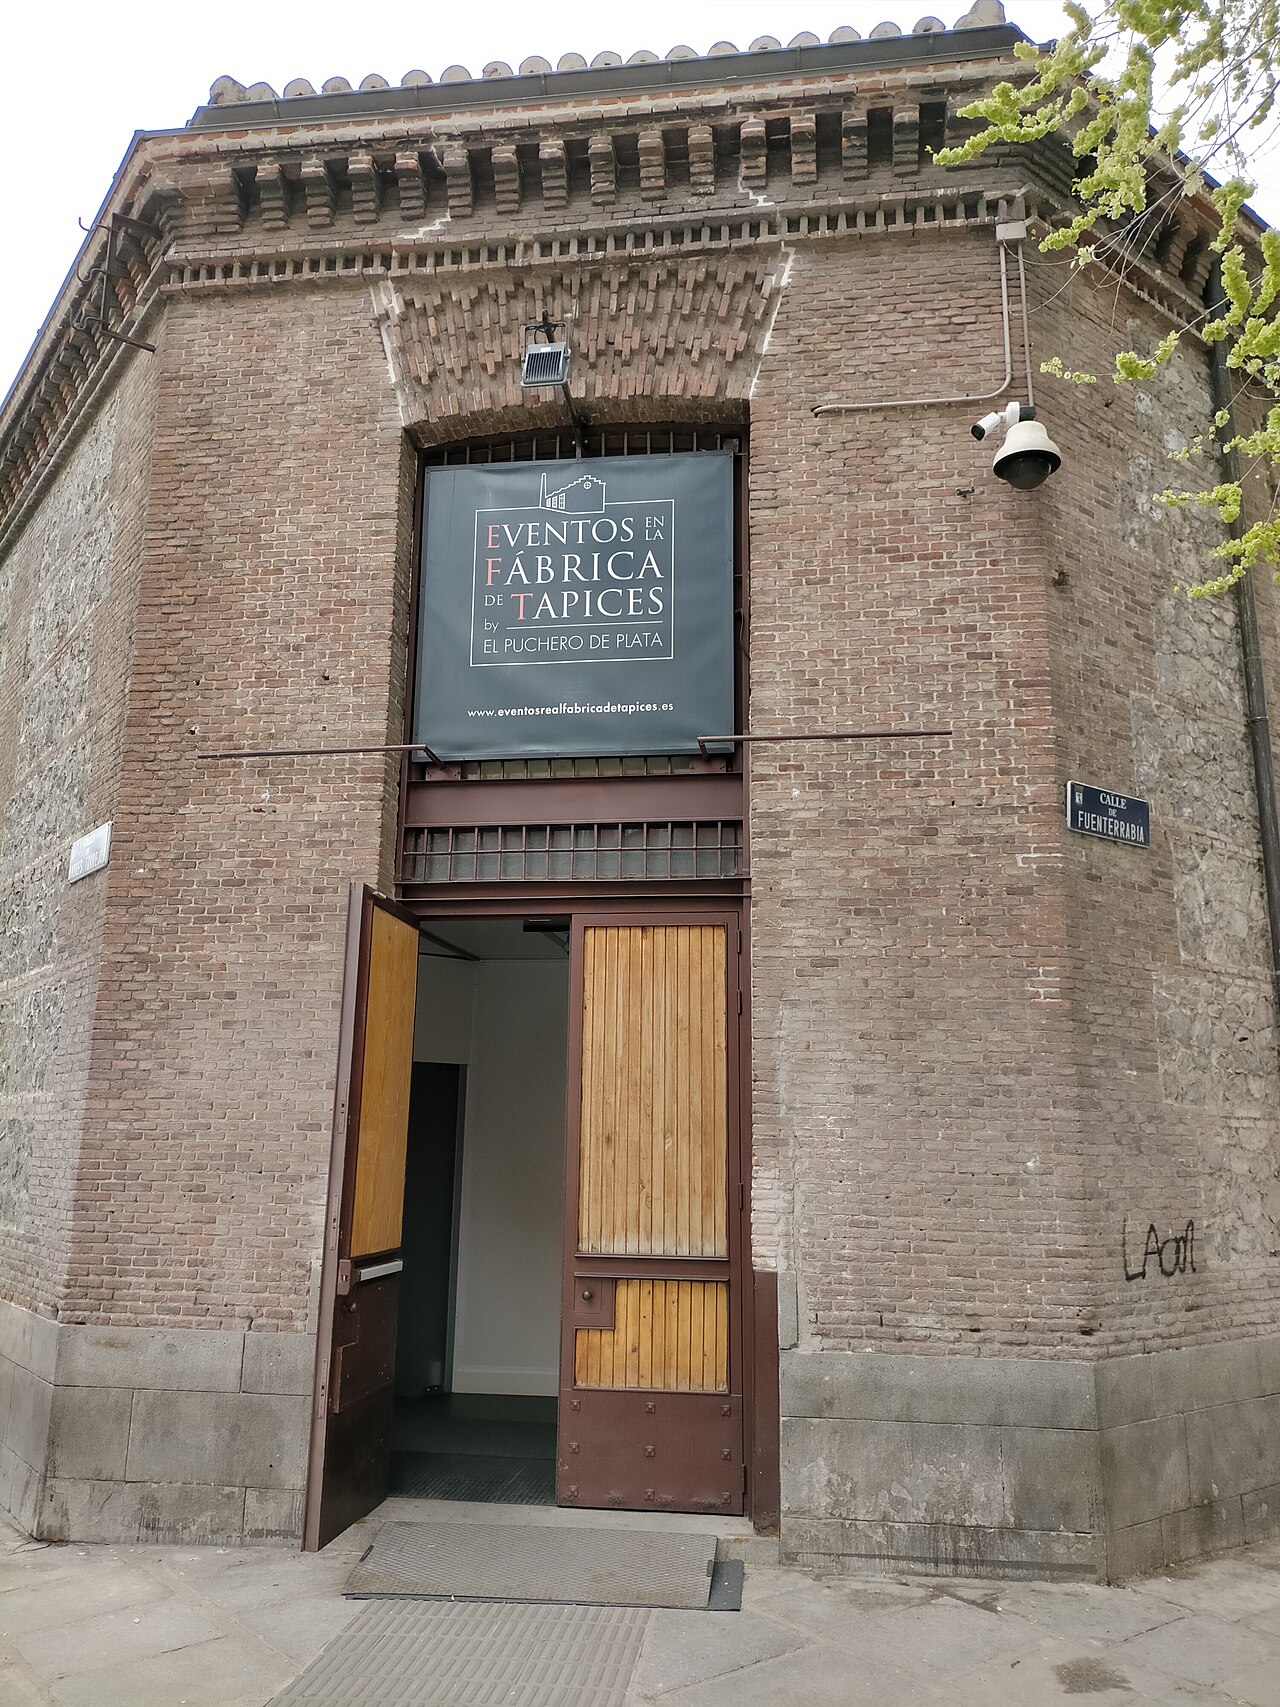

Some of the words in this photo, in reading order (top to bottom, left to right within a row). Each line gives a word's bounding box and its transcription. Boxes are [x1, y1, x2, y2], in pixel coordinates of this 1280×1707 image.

[645, 516, 665, 528] EN
[486, 517, 634, 549] EVENTOS
[645, 529, 665, 541] LA
[485, 550, 665, 587] FÁBRICA
[484, 594, 504, 606] DE
[510, 586, 664, 620] TAPICES
[484, 618, 499, 633] by
[483, 639, 499, 654] EL
[504, 635, 584, 653] PUCHERO
[589, 634, 610, 649] DE
[616, 632, 663, 648] PLATA
[467, 701, 674, 717] www.eventosrealfabricadetapices.es
[1099, 793, 1127, 810] CALLE
[1108, 807, 1117, 818] DE
[1078, 810, 1145, 843] FUENTERRABIA
